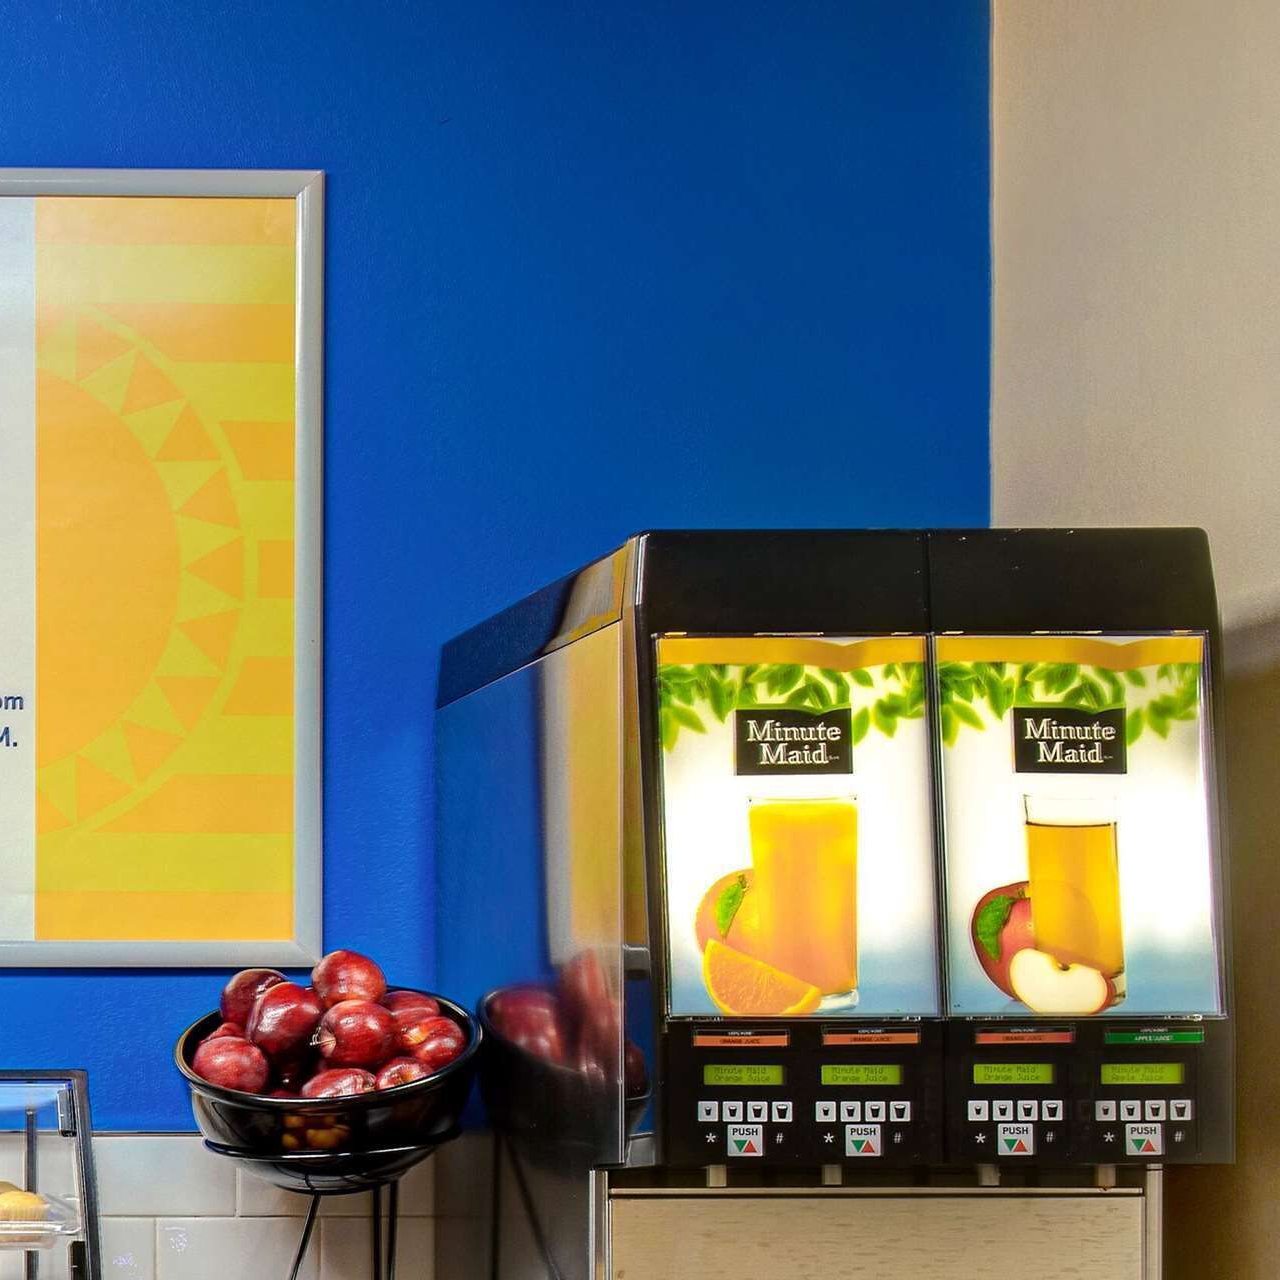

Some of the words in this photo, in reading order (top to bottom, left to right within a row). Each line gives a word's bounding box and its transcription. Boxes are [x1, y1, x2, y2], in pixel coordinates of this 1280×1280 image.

[746, 719, 842, 742] Minute
[1024, 717, 1117, 741] Minute
[758, 742, 830, 765] Maid
[1037, 741, 1105, 763] Maid
[732, 1128, 759, 1136] PUSH
[849, 1128, 877, 1136] PUSH
[1002, 1127, 1029, 1135] PUSH
[1130, 1127, 1157, 1135] PUSH
